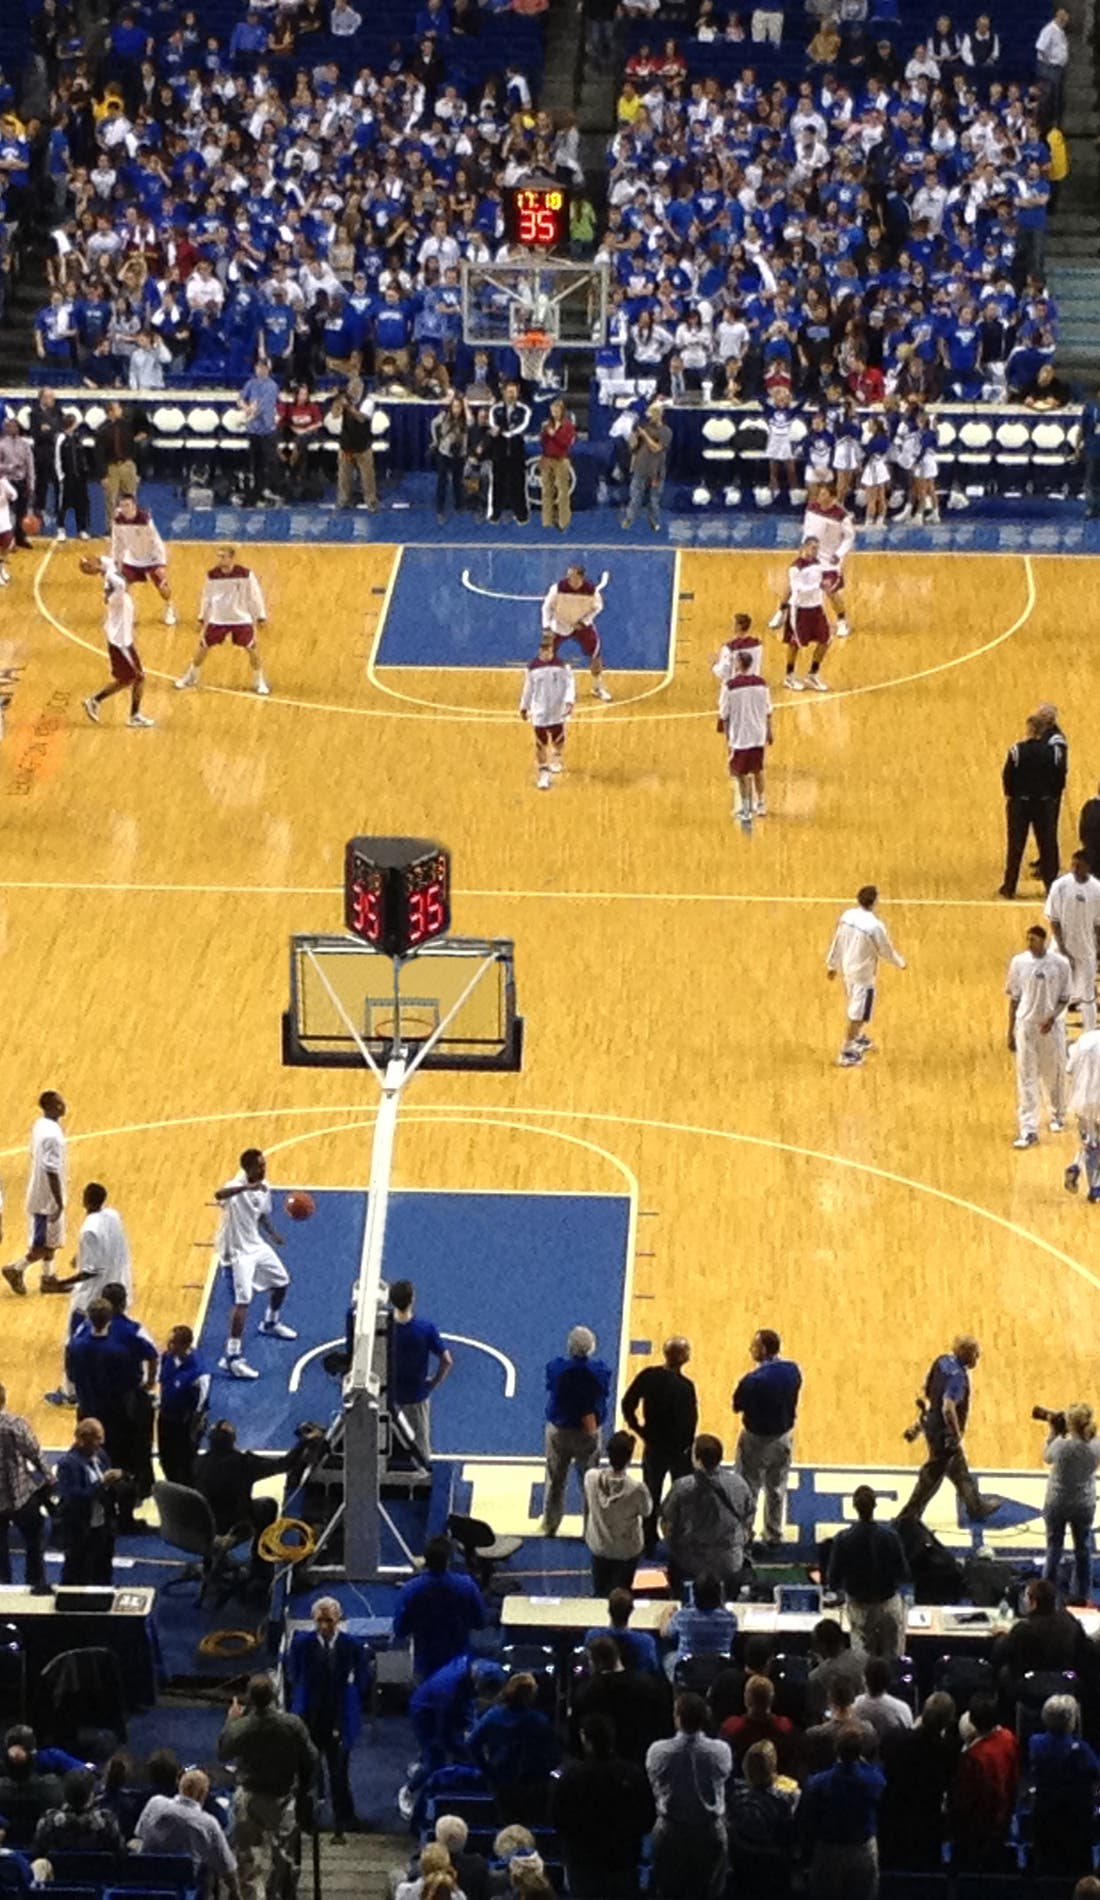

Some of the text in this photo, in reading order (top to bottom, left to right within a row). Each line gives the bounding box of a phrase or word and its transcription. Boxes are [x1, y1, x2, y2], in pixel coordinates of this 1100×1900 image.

[520, 209, 555, 240] 35
[353, 883, 378, 939] 35
[410, 884, 443, 941] 35
